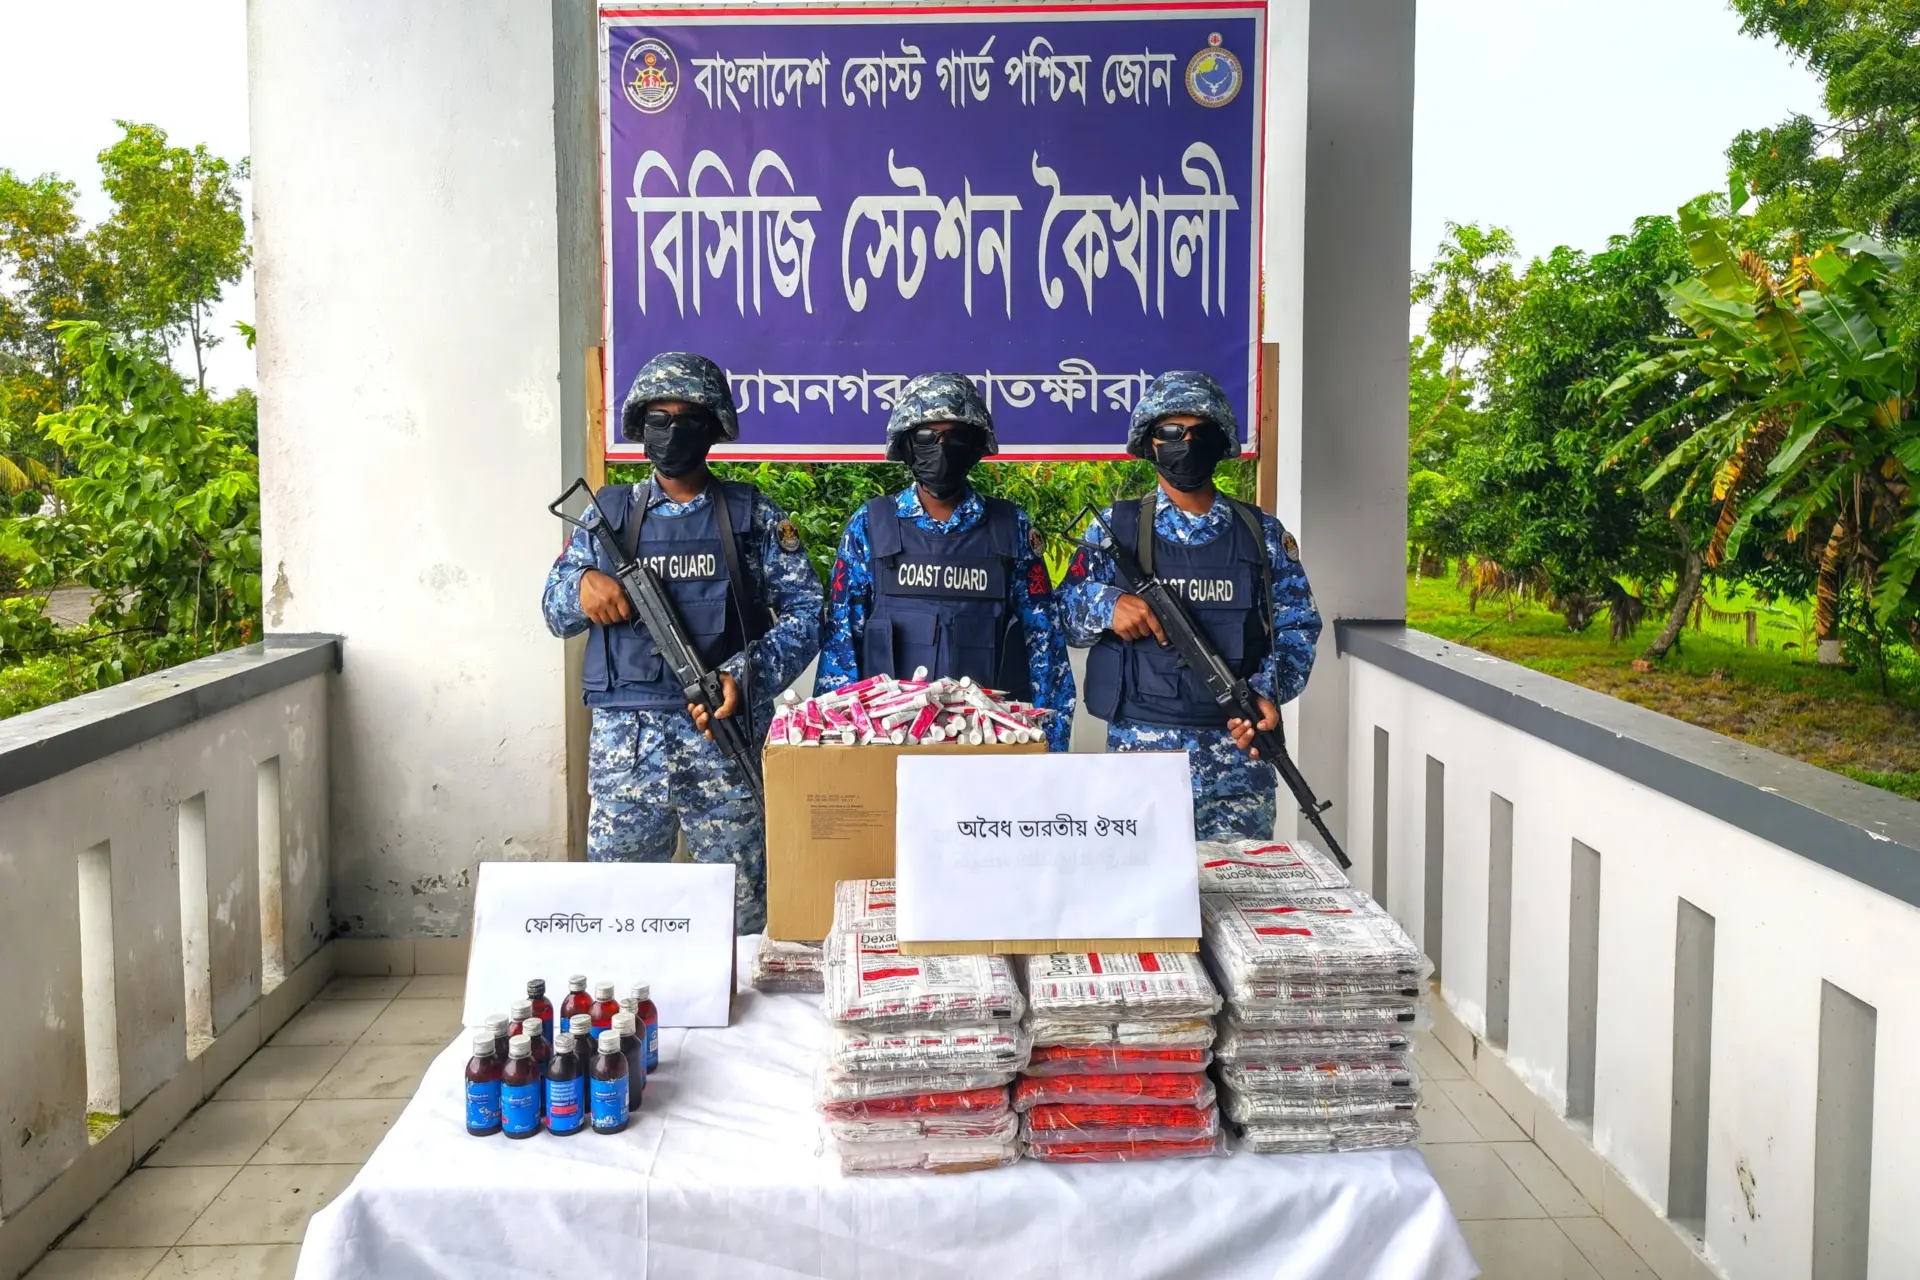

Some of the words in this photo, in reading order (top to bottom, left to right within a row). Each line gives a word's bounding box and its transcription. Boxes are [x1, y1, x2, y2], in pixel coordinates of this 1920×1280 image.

[691, 50, 831, 112] বাংলাদেশ
[842, 38, 927, 109] কোস্ট
[935, 35, 996, 108] গার্ড
[1004, 36, 1092, 106] পশ্চিম
[1102, 47, 1177, 105] জোন
[625, 149, 822, 319] বিসিজি
[842, 148, 1023, 320] স্টেশন
[1032, 141, 1239, 319] কৈখালী
[669, 553, 716, 579] GUARD
[898, 563, 941, 588] COAST
[943, 565, 988, 591] GUARD
[1188, 578, 1234, 602] GUARD
[956, 815, 1012, 838] অবৈধ
[1017, 813, 1088, 838] ভারতীয়
[1094, 815, 1138, 837] ঔষধ
[525, 913, 603, 934] ফেন্সিডিল
[641, 918, 691, 934] বোতল
